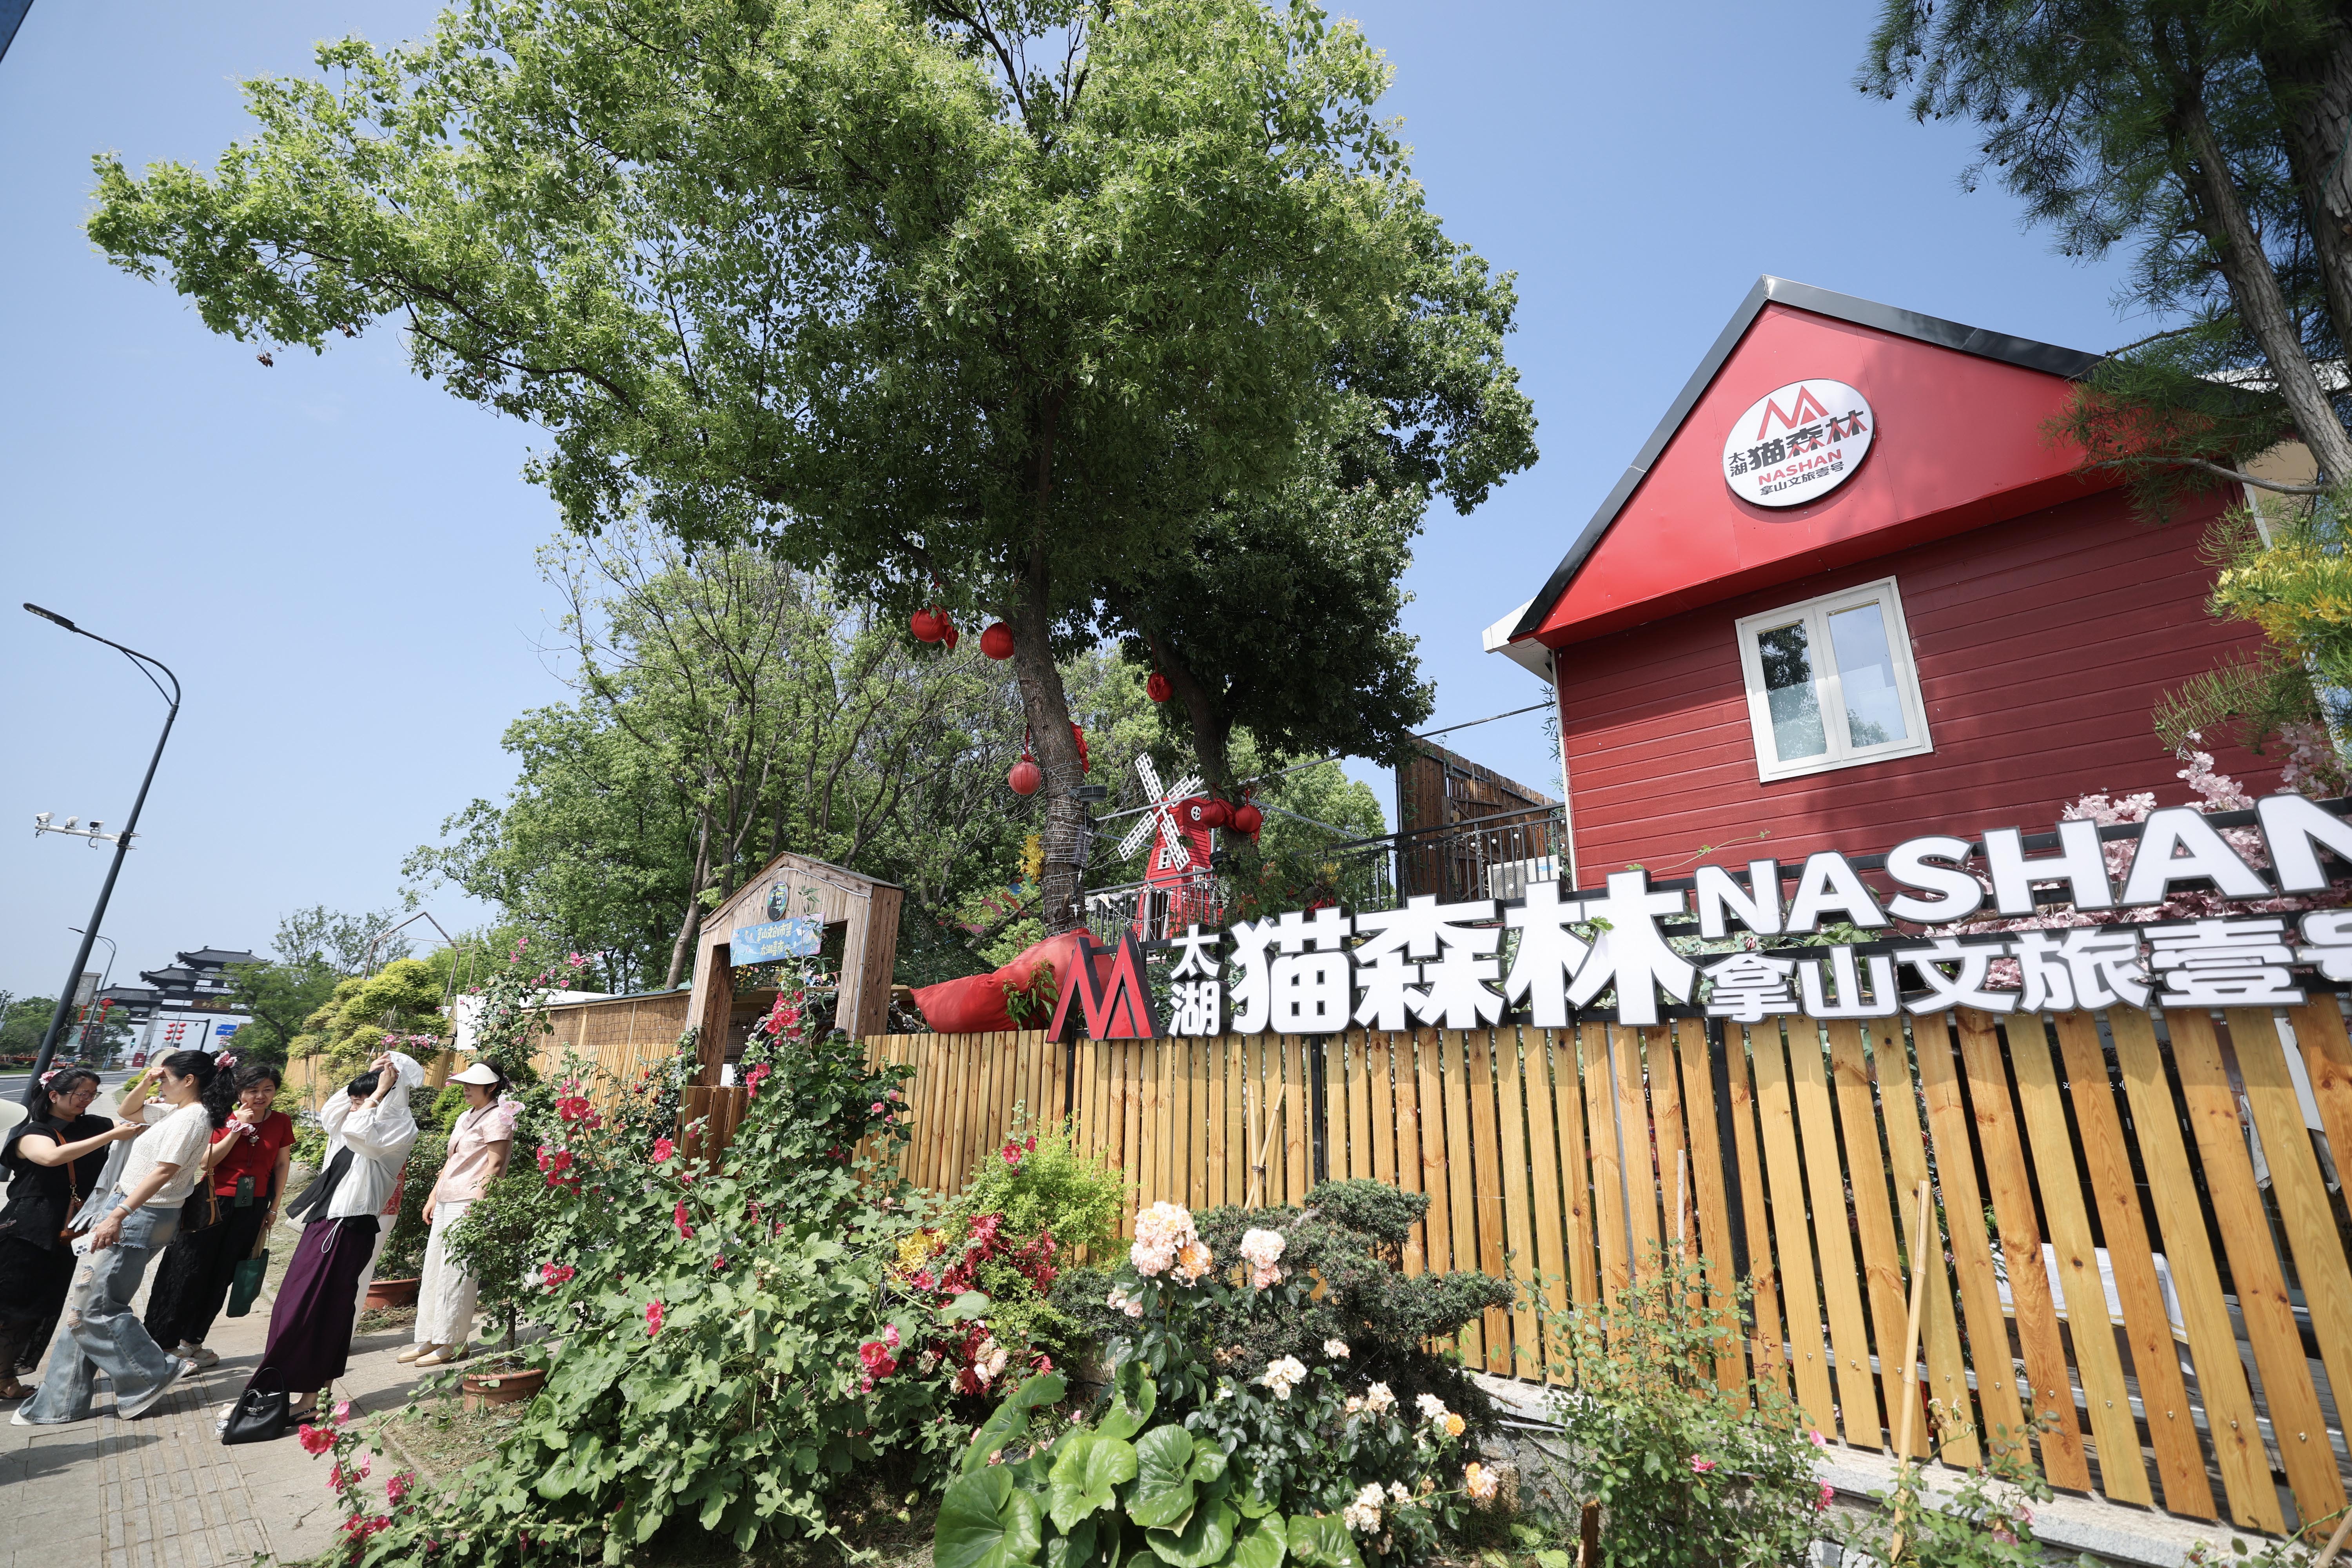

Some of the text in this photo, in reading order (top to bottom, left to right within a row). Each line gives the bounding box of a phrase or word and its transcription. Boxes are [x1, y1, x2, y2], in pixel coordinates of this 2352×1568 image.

[1748, 410, 1868, 470] 猫森林
[1759, 448, 1842, 486] NASHAN
[1760, 461, 1844, 496] 拿山文旅壹号
[1693, 792, 2352, 939] NASHAN
[1229, 870, 1697, 1034] 猫森林
